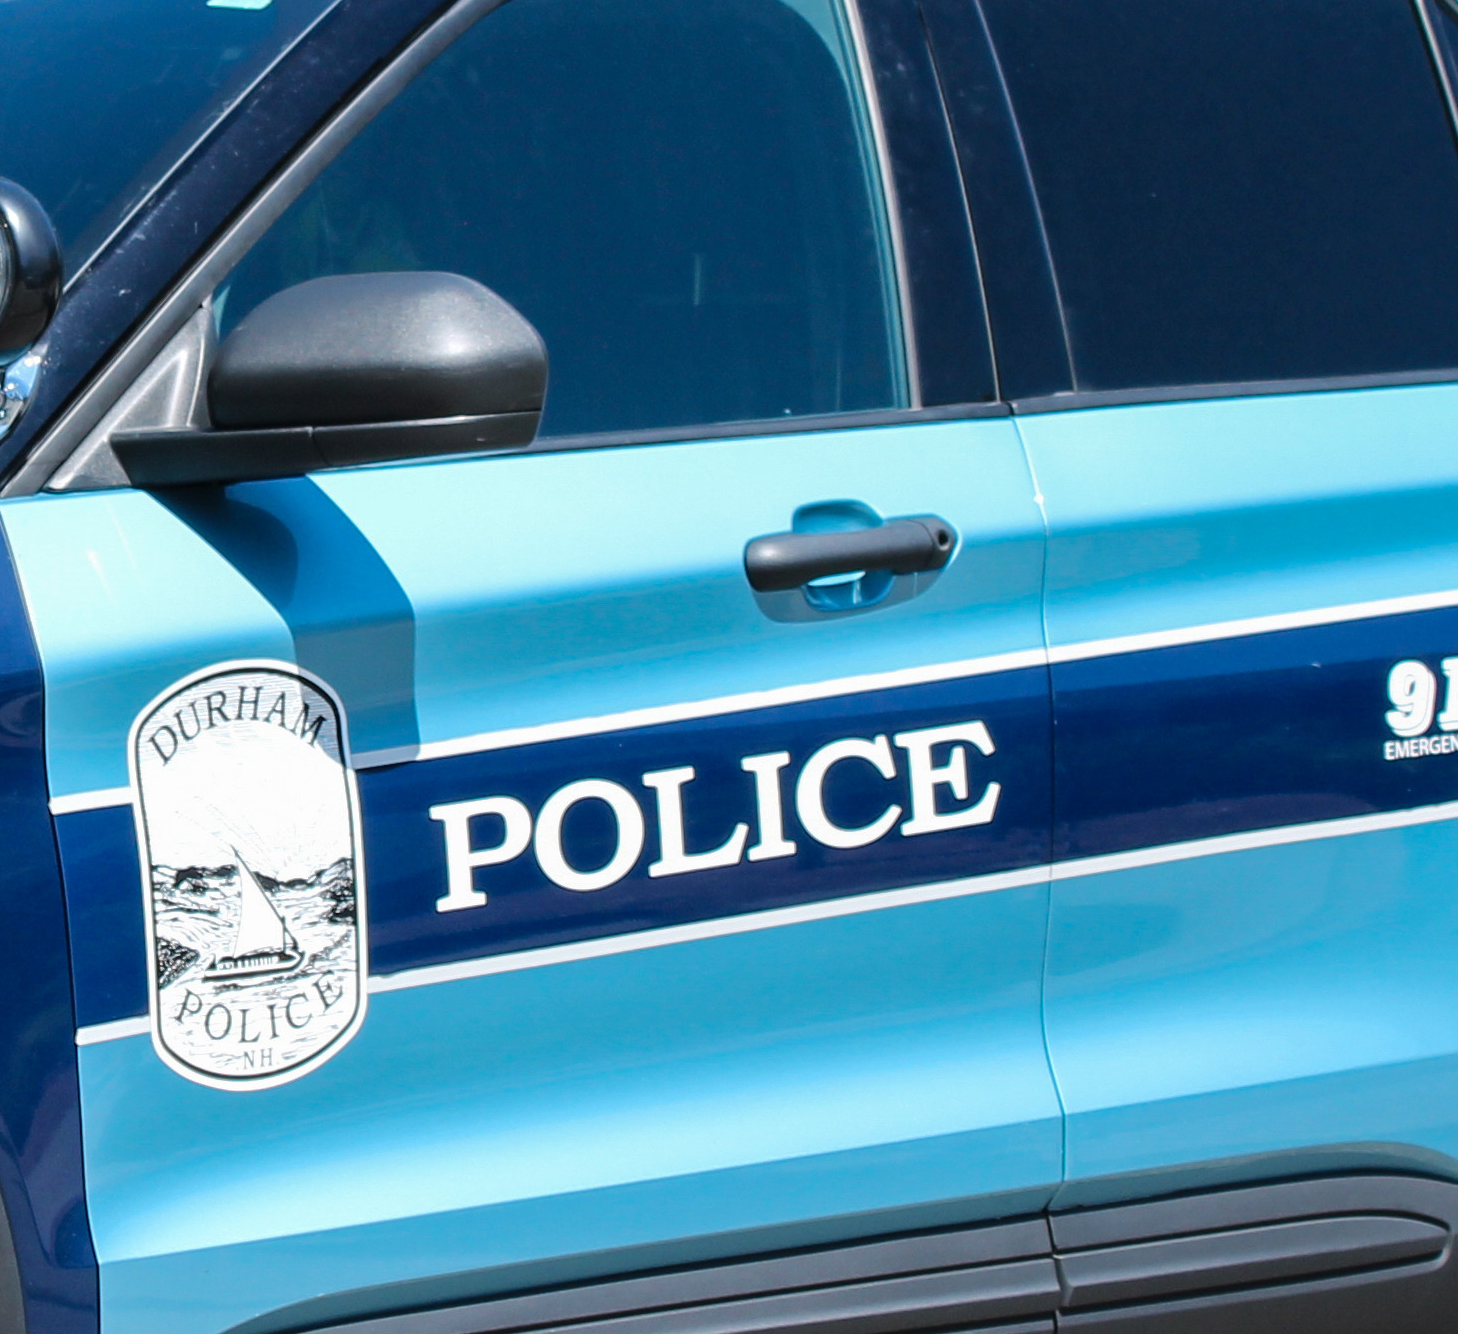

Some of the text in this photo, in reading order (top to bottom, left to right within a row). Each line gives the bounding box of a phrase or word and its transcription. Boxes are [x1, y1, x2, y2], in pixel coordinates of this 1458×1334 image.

[147, 685, 328, 767] DURHAM
[428, 720, 1002, 913] POLICE
[174, 969, 345, 1044] POLICE
